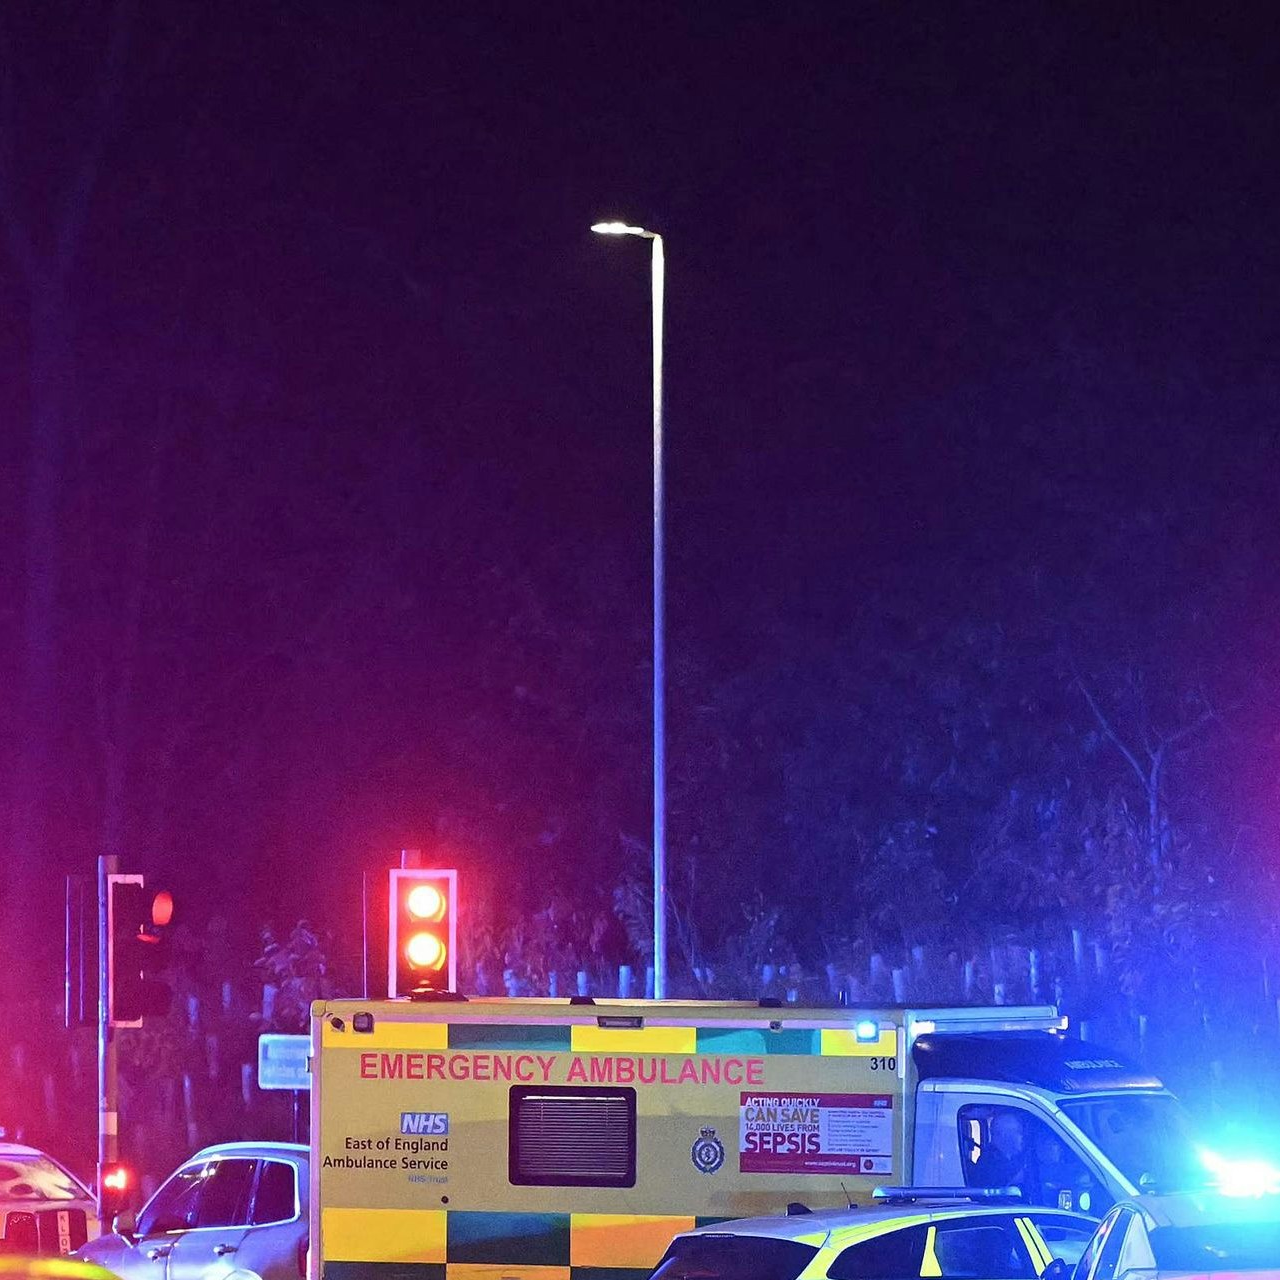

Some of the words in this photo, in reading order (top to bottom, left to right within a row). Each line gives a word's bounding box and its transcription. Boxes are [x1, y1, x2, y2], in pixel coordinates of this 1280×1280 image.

[360, 1053, 556, 1082] EMERGENCY
[567, 1056, 765, 1085] AMBULANCE
[870, 1057, 896, 1070] 310
[745, 1097, 779, 1107] ACTING
[781, 1097, 819, 1107] QUICKLY
[745, 1107, 778, 1122] CAN
[781, 1108, 819, 1123] SAVE
[402, 1113, 447, 1134] NHS
[745, 1123, 770, 1132] 14,000
[772, 1124, 794, 1132] LIVES
[797, 1124, 819, 1133] FROM
[345, 1137, 372, 1150] East
[376, 1137, 391, 1150] of
[395, 1138, 448, 1153] England
[744, 1132, 820, 1153] SEPSIS
[323, 1155, 397, 1169] Ambulance
[401, 1157, 448, 1169] Service
